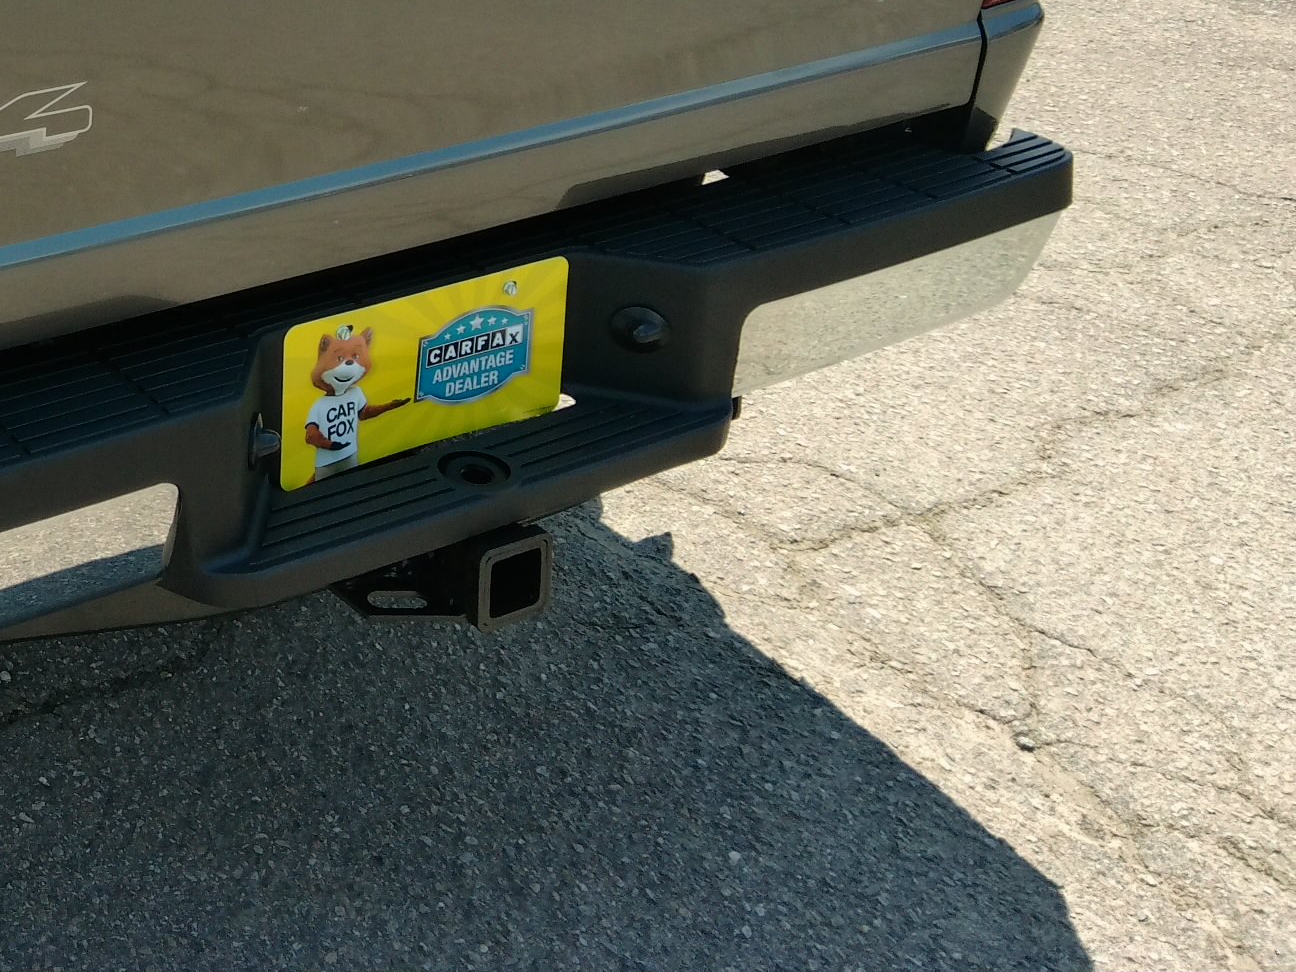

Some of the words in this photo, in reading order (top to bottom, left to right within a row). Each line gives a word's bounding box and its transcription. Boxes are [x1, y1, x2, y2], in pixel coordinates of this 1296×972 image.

[426, 324, 524, 368] CARFAX
[432, 349, 514, 384] ADVANTAGE
[445, 370, 499, 397] DEALER
[328, 418, 355, 440] FOX
